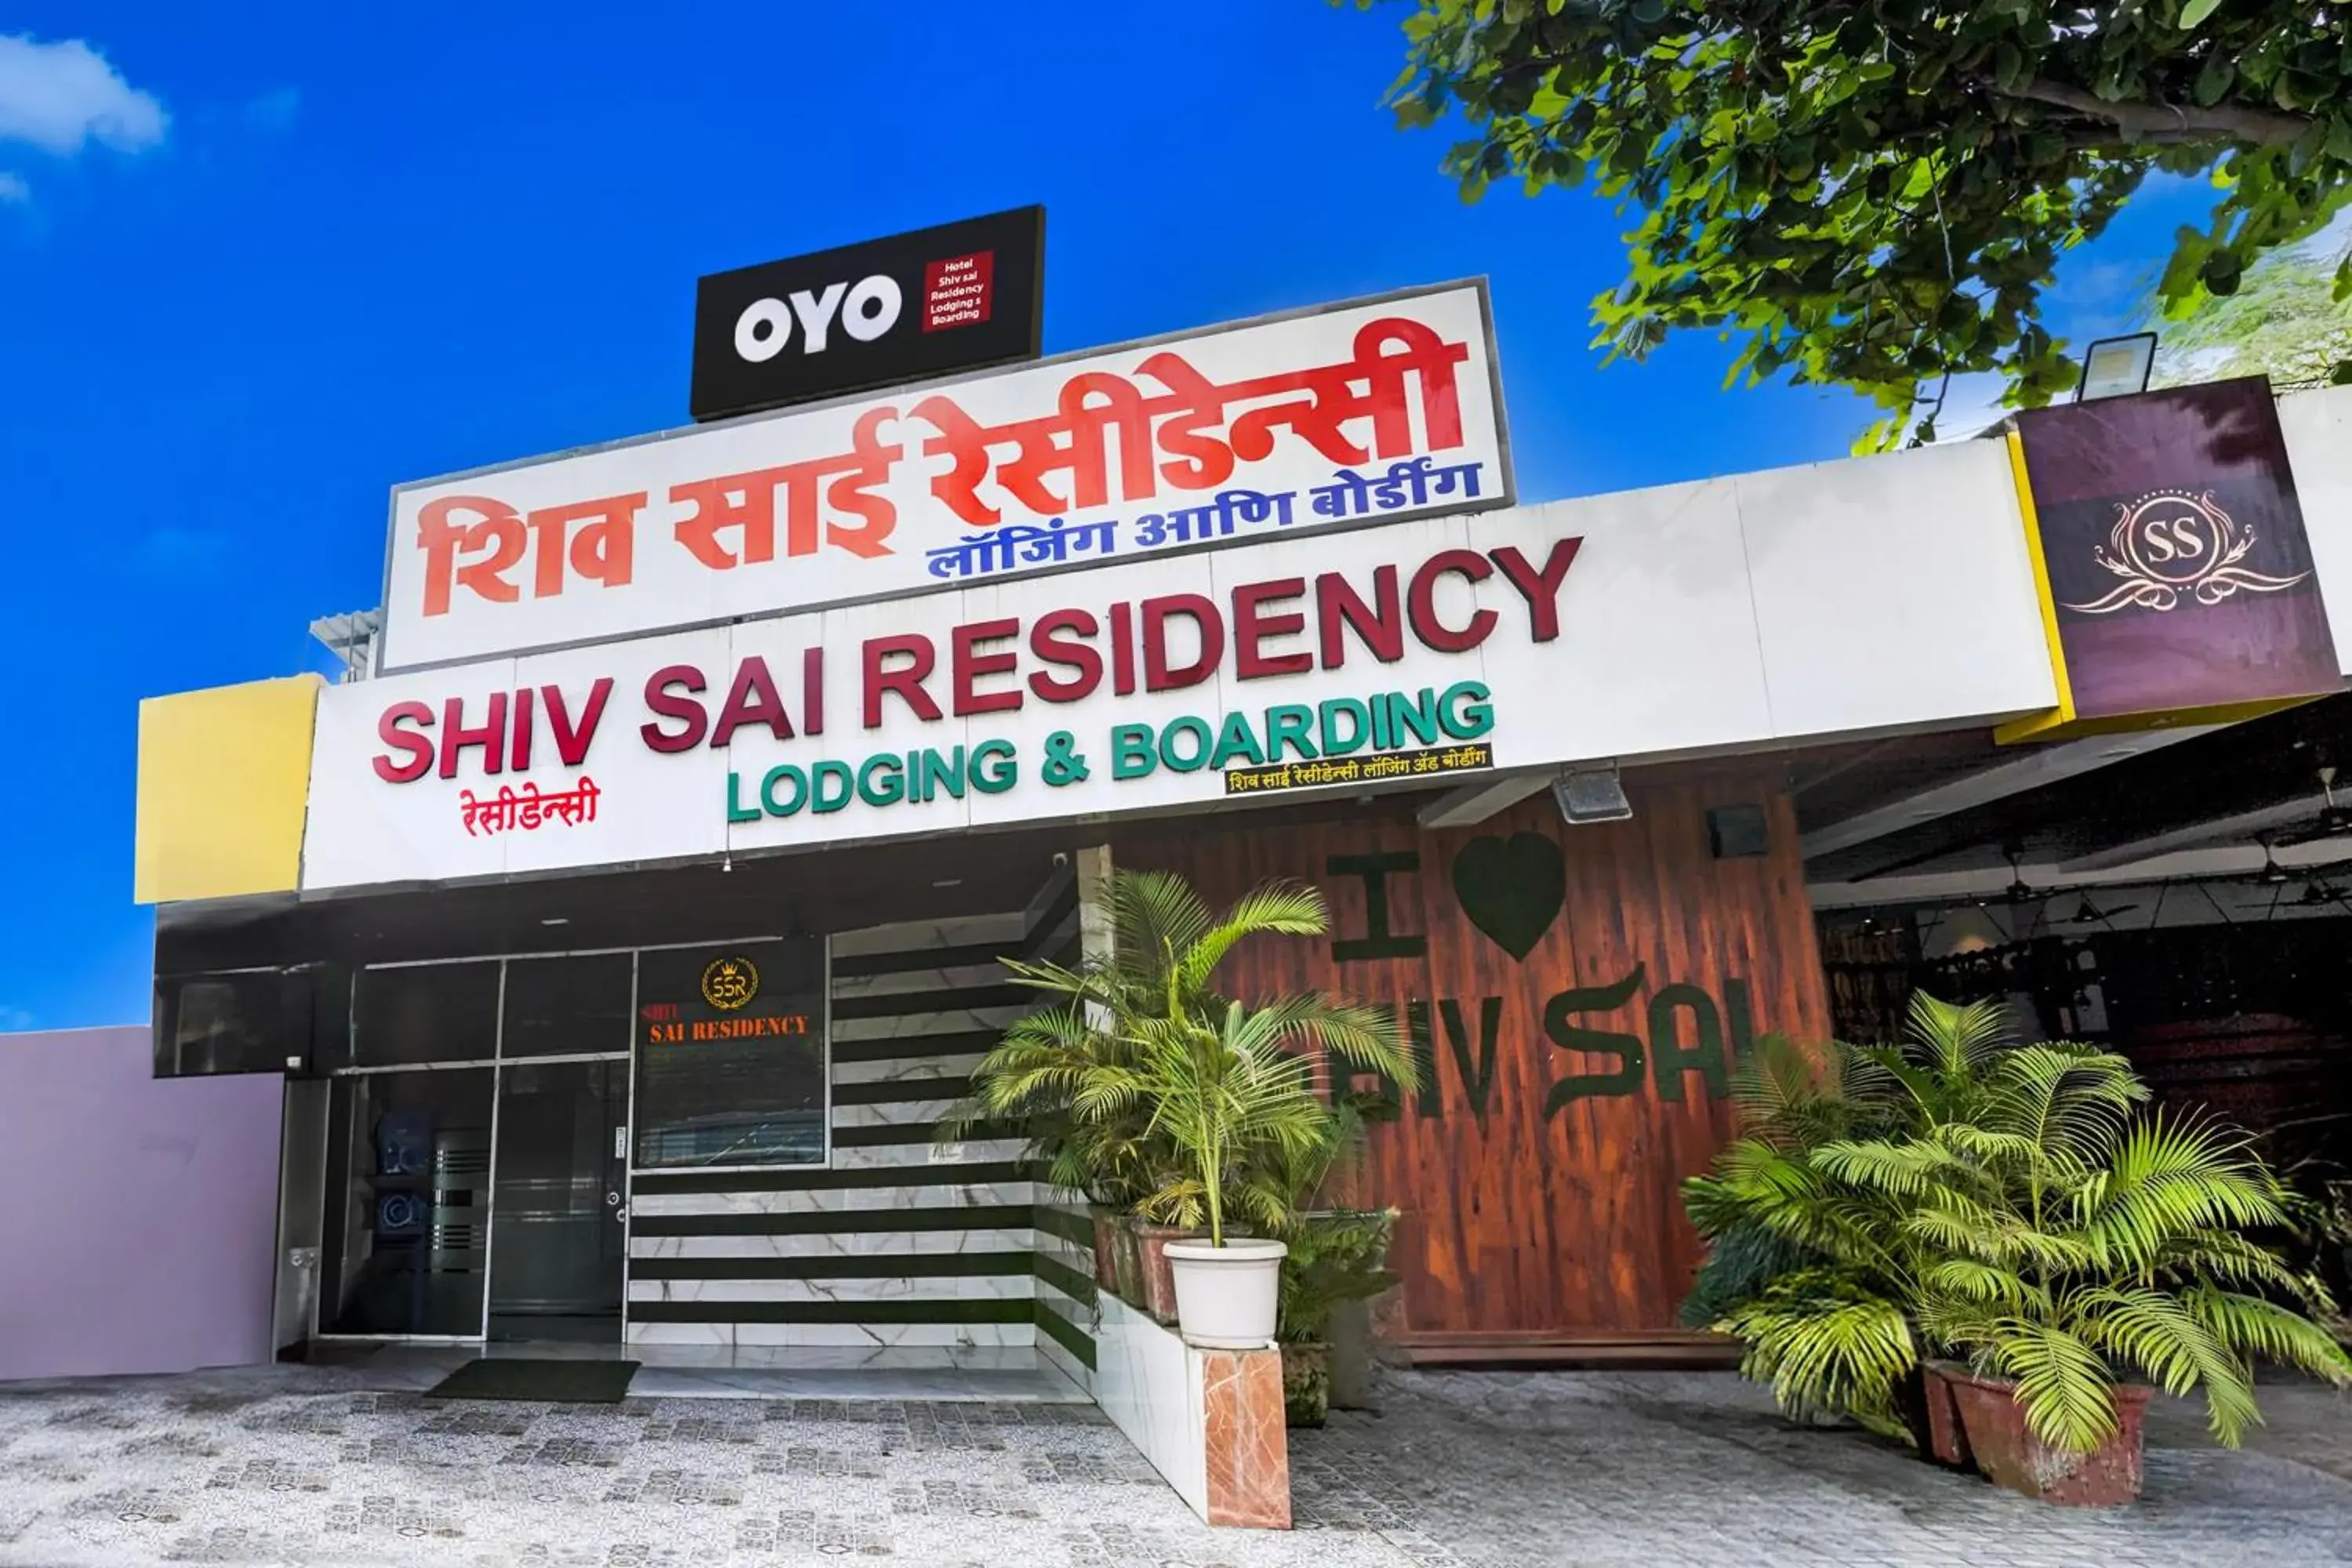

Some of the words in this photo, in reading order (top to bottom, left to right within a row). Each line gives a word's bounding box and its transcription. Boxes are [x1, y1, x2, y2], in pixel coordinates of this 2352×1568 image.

[938, 275, 961, 287] Shiv
[945, 258, 973, 272] Hotel
[931, 284, 984, 301] Residency
[931, 299, 973, 314] Lodging
[735, 274, 902, 363] OYO
[932, 310, 979, 325] Boarding
[416, 495, 648, 617] शिव
[669, 405, 904, 570] साई
[904, 318, 1468, 527] रेसीडेन्सी
[926, 517, 1119, 578] लॉजिंग
[1135, 489, 1296, 546] आणि
[2144, 517, 2204, 563] SS
[372, 677, 613, 784] SHIV
[640, 648, 823, 753] SAI
[862, 535, 1584, 728] RESIDENCY
[728, 739, 1018, 823] LODGING
[1042, 730, 1091, 786] &
[1112, 681, 1494, 781] BOARDING
[460, 776, 601, 837] रेसीडेन्सी
[1327, 851, 1427, 963] I
[713, 975, 746, 997] SSR
[650, 1023, 684, 1044] SAI
[693, 1015, 808, 1041] RESIDENCY
